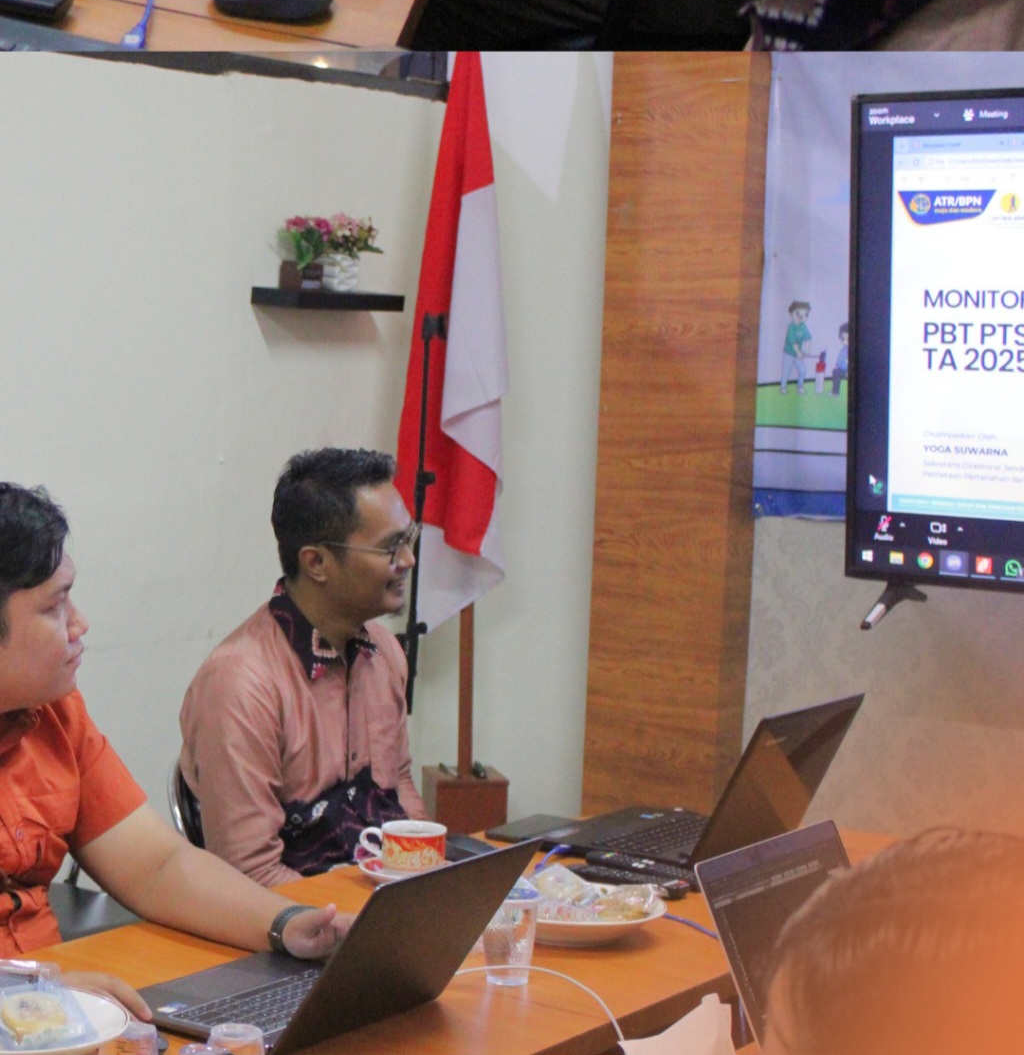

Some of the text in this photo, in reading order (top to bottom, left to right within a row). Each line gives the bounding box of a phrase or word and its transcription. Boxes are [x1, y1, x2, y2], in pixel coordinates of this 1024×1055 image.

[869, 107, 889, 116] zoom
[979, 109, 1009, 120] Meeting
[868, 115, 916, 126] Workplace
[933, 195, 983, 207] ATR/BPN
[923, 321, 974, 345] PBT
[922, 347, 957, 371] TA
[923, 444, 1008, 457] YOGA SUWARNA
[874, 532, 895, 542] Audio
[927, 536, 949, 546] Video
